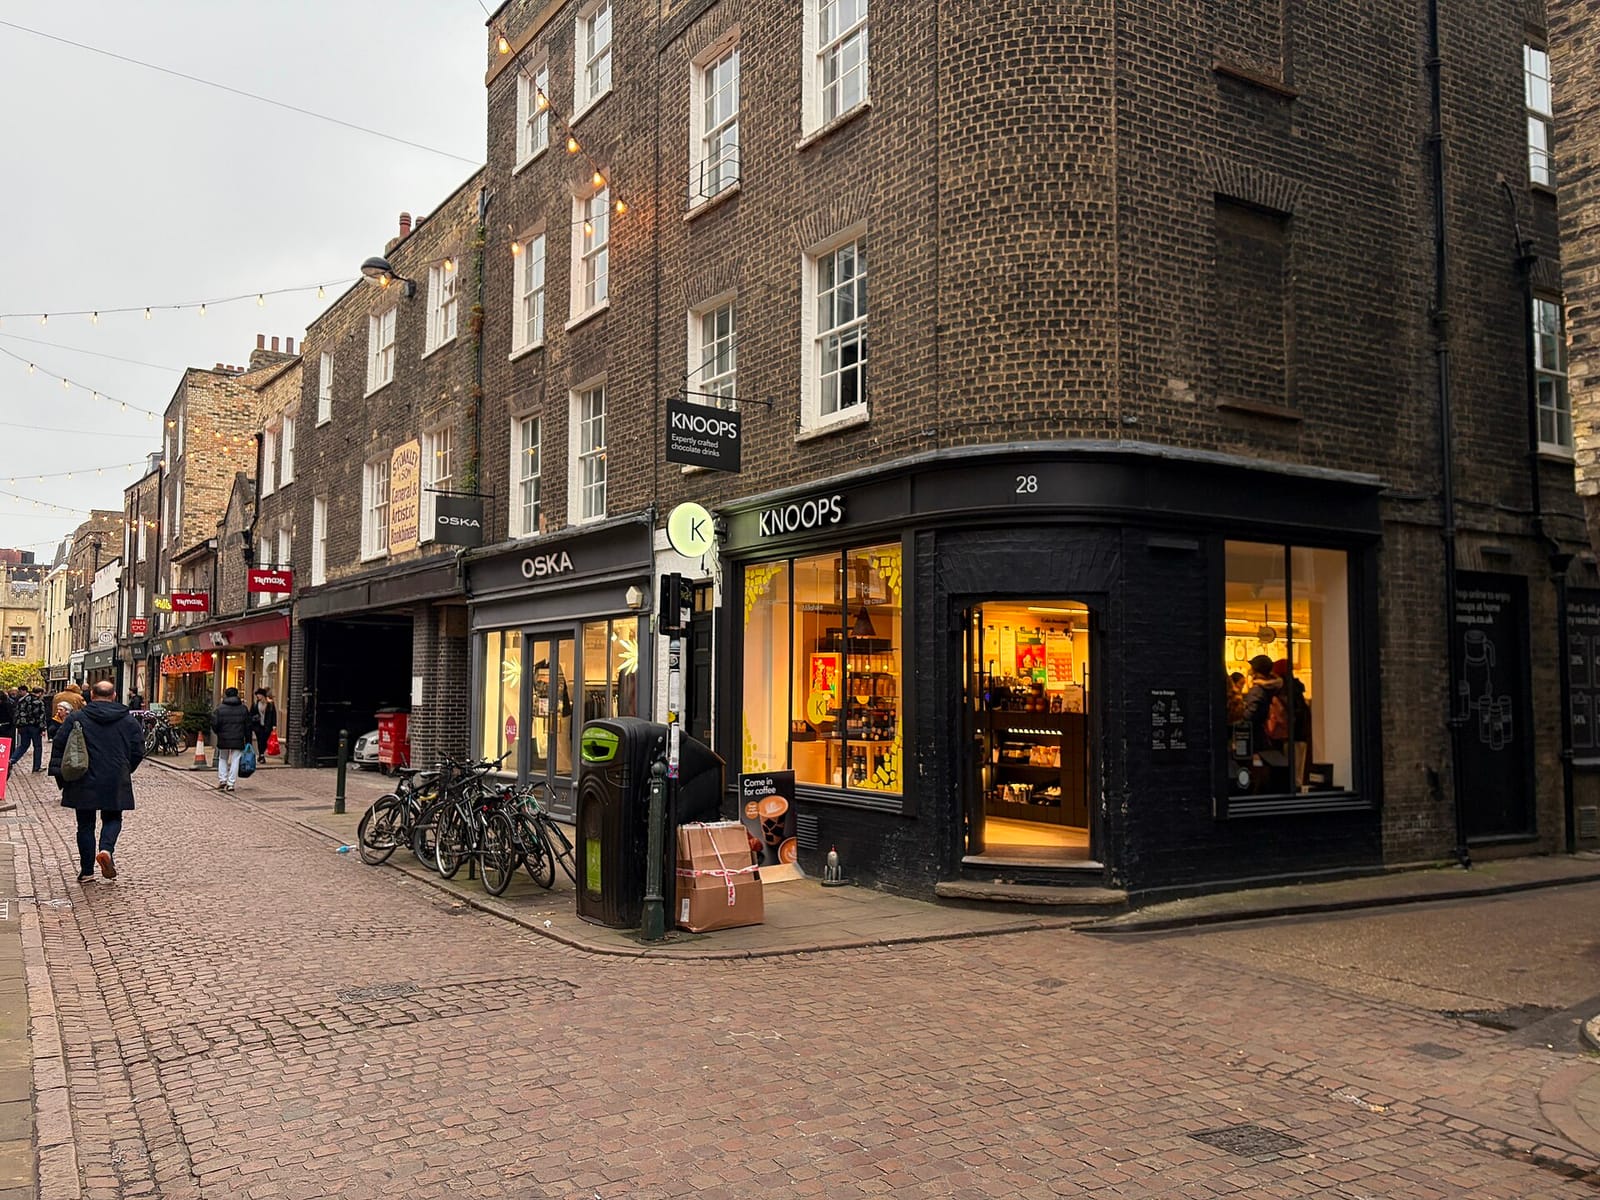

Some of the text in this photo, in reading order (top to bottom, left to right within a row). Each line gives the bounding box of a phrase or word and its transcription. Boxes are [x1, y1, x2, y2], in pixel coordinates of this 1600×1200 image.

[671, 411, 738, 439] KNOOPS
[671, 433, 719, 449] Expertly crafted
[671, 442, 720, 457] chocolate drinks
[1015, 475, 1038, 493] 28
[438, 515, 480, 528] OSKA
[759, 494, 842, 537] KNOOPS
[691, 517, 706, 543] K
[521, 551, 574, 578] OSKA
[815, 700, 824, 715] K
[505, 725, 517, 735] SALE
[743, 777, 773, 788] Come in
[743, 786, 777, 796] for coffee
